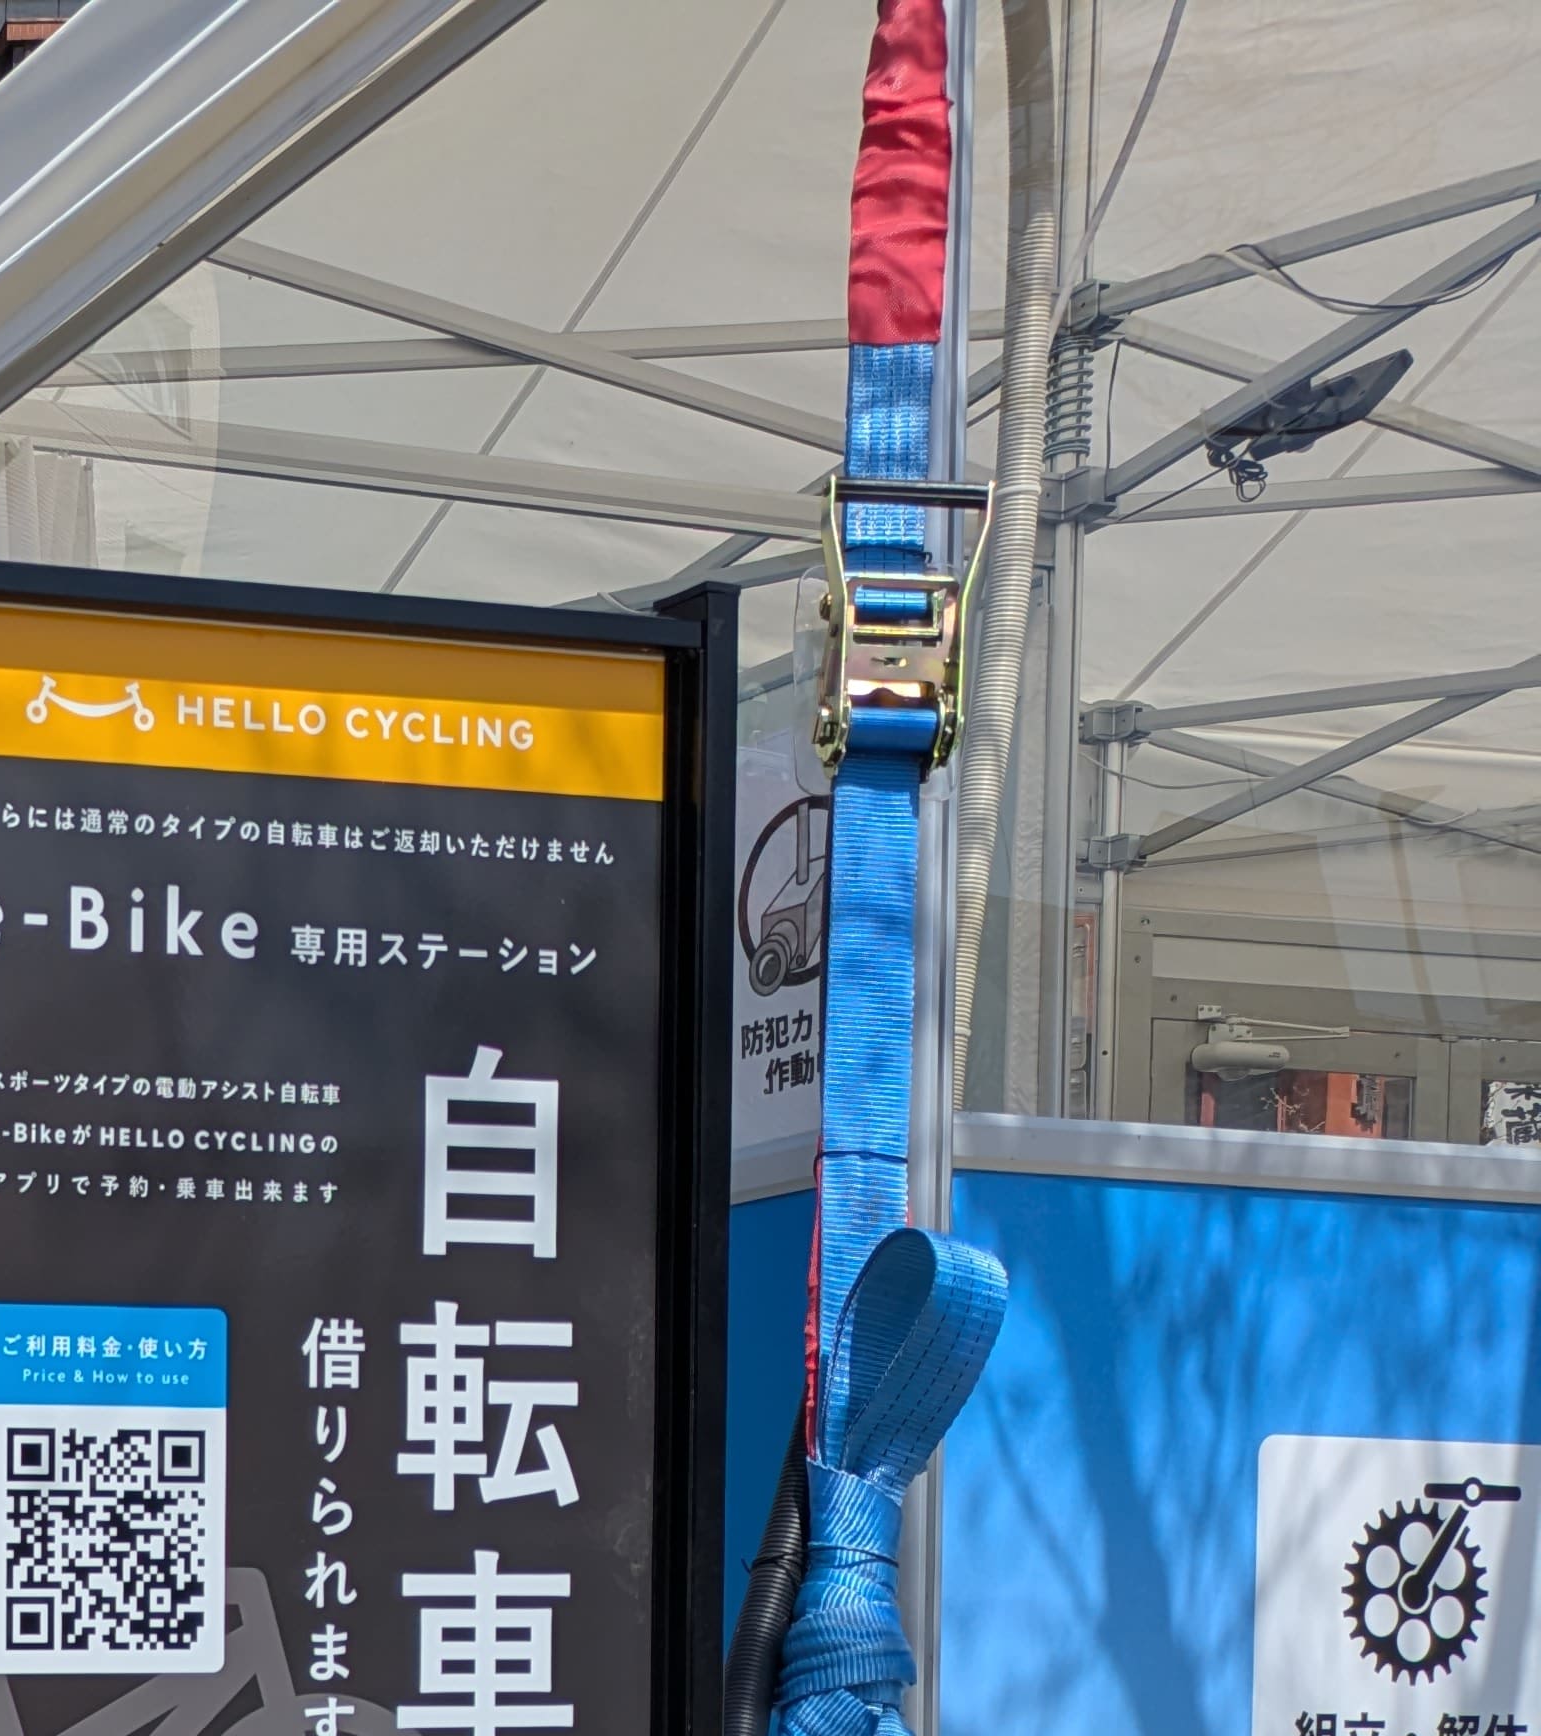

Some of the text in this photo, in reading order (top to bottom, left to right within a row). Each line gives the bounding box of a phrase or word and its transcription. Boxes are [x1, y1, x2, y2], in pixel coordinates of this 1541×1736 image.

[177, 694, 536, 751] HELLO CYCLING
[290, 923, 600, 979] 専用ステーション
[763, 1049, 821, 1095] 作動
[99, 1125, 186, 1150] HELLO
[193, 1130, 339, 1156] CYCLINGの
[1, 1330, 210, 1363] ご利用料金・使い方
[22, 1367, 190, 1387] Price & How to use
